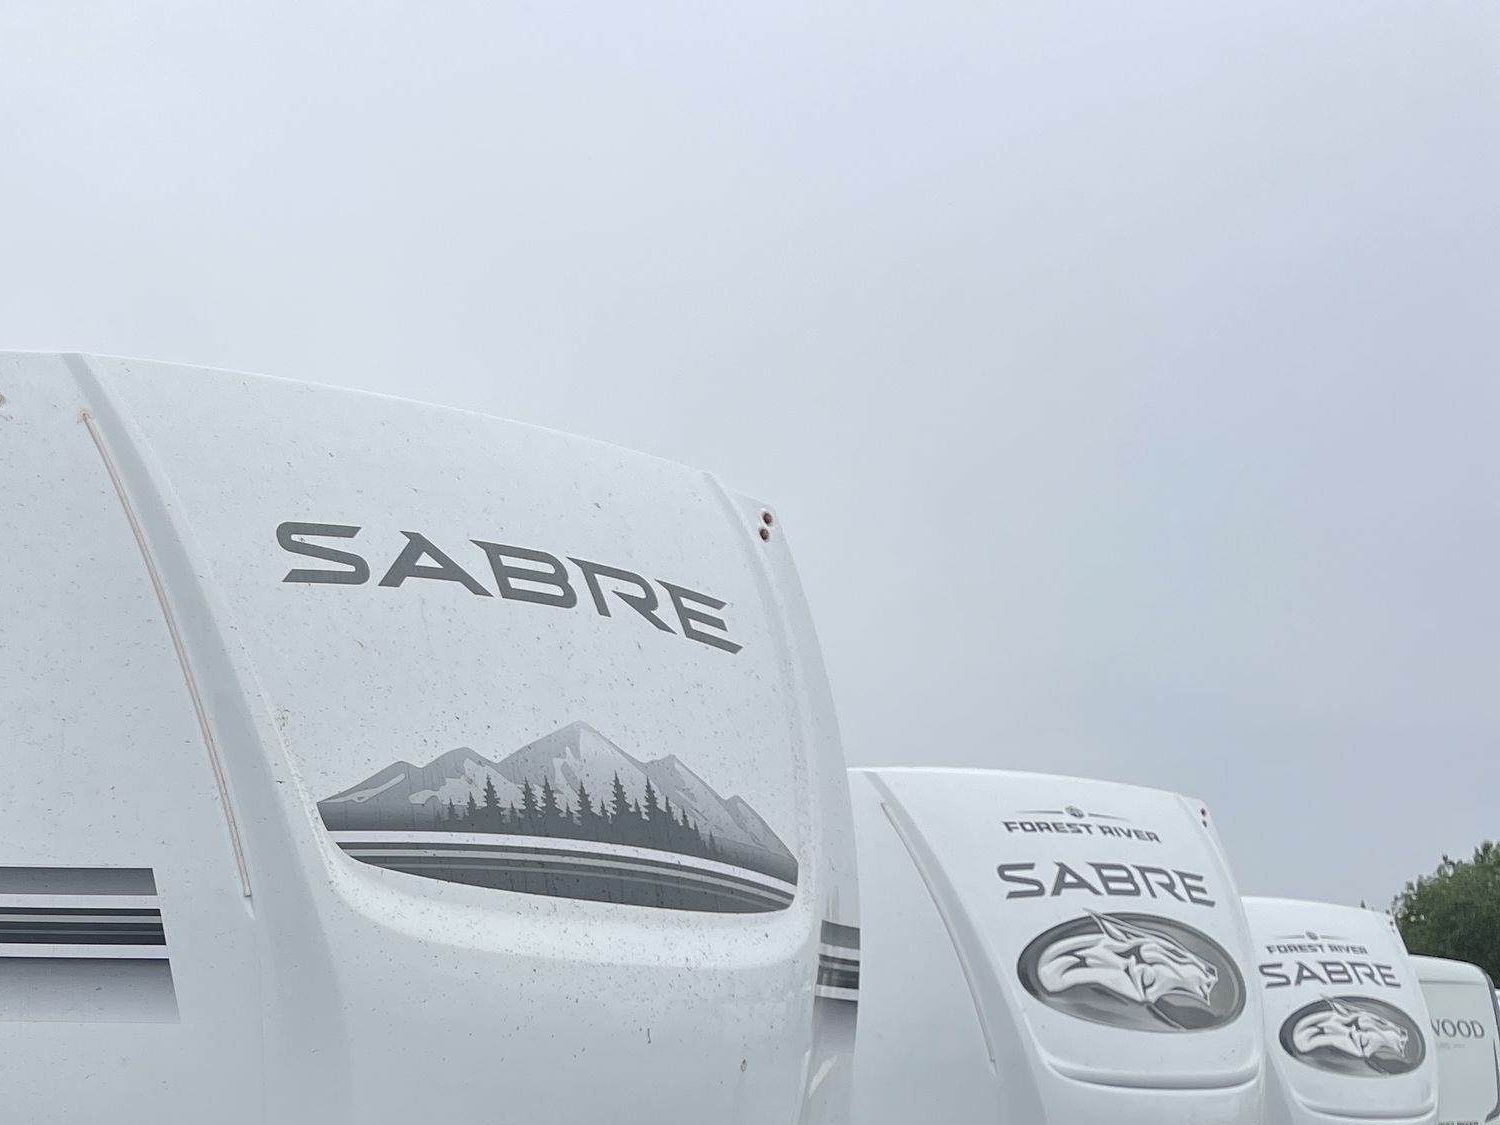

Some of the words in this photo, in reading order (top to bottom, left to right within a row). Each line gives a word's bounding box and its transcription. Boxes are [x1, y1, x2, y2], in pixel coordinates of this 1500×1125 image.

[276, 521, 743, 654] SABRE
[1002, 821, 1094, 835] FOREST
[1098, 824, 1162, 843] RIVER
[997, 861, 1216, 907] SABRE
[1266, 944, 1326, 954] FOREST
[1327, 944, 1368, 955] RIVER
[1258, 961, 1401, 989] SABRE
